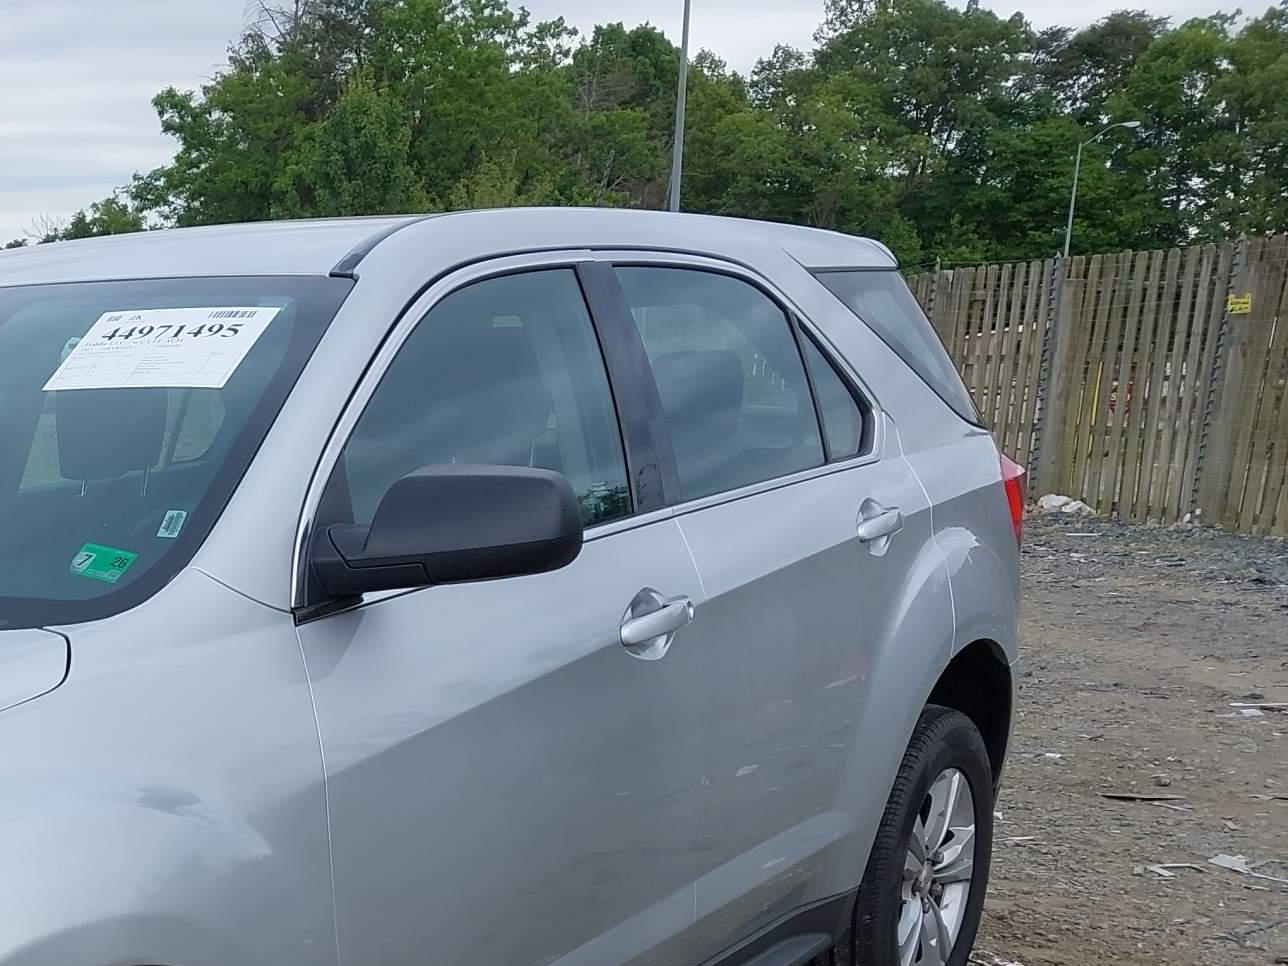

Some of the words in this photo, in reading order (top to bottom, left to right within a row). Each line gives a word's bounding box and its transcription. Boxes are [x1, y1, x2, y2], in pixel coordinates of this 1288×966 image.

[101, 323, 245, 341] 44971495
[78, 553, 93, 567] 7
[111, 556, 129, 569] 26
